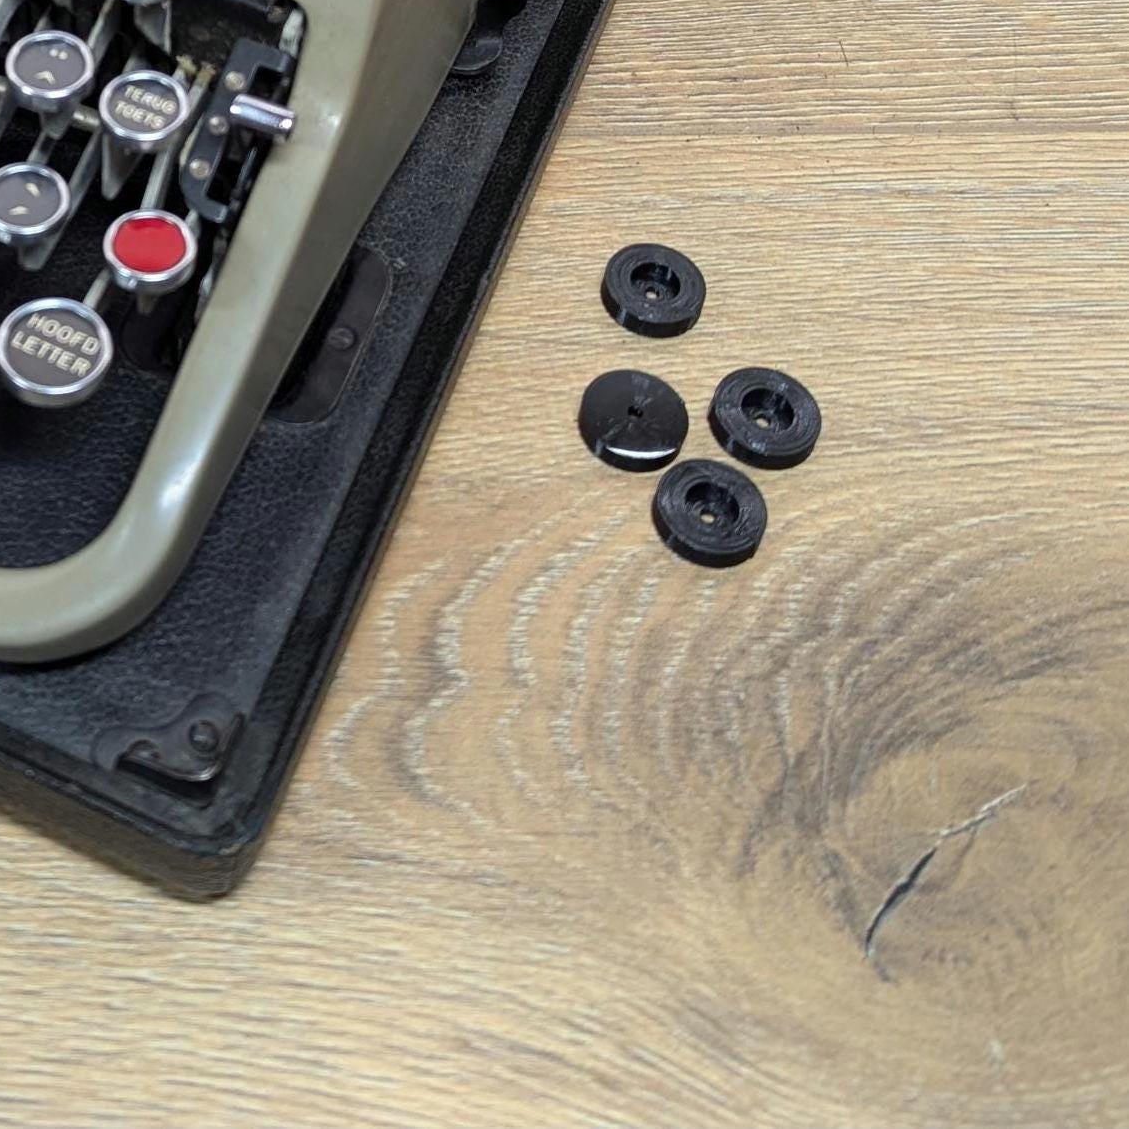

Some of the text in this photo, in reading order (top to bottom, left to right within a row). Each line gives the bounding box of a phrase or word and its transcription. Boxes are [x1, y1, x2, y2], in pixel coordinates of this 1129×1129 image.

[114, 101, 165, 131] TOETS
[125, 85, 176, 116] TERUG
[26, 312, 101, 357] HOOFD
[10, 330, 92, 378] LETTER
